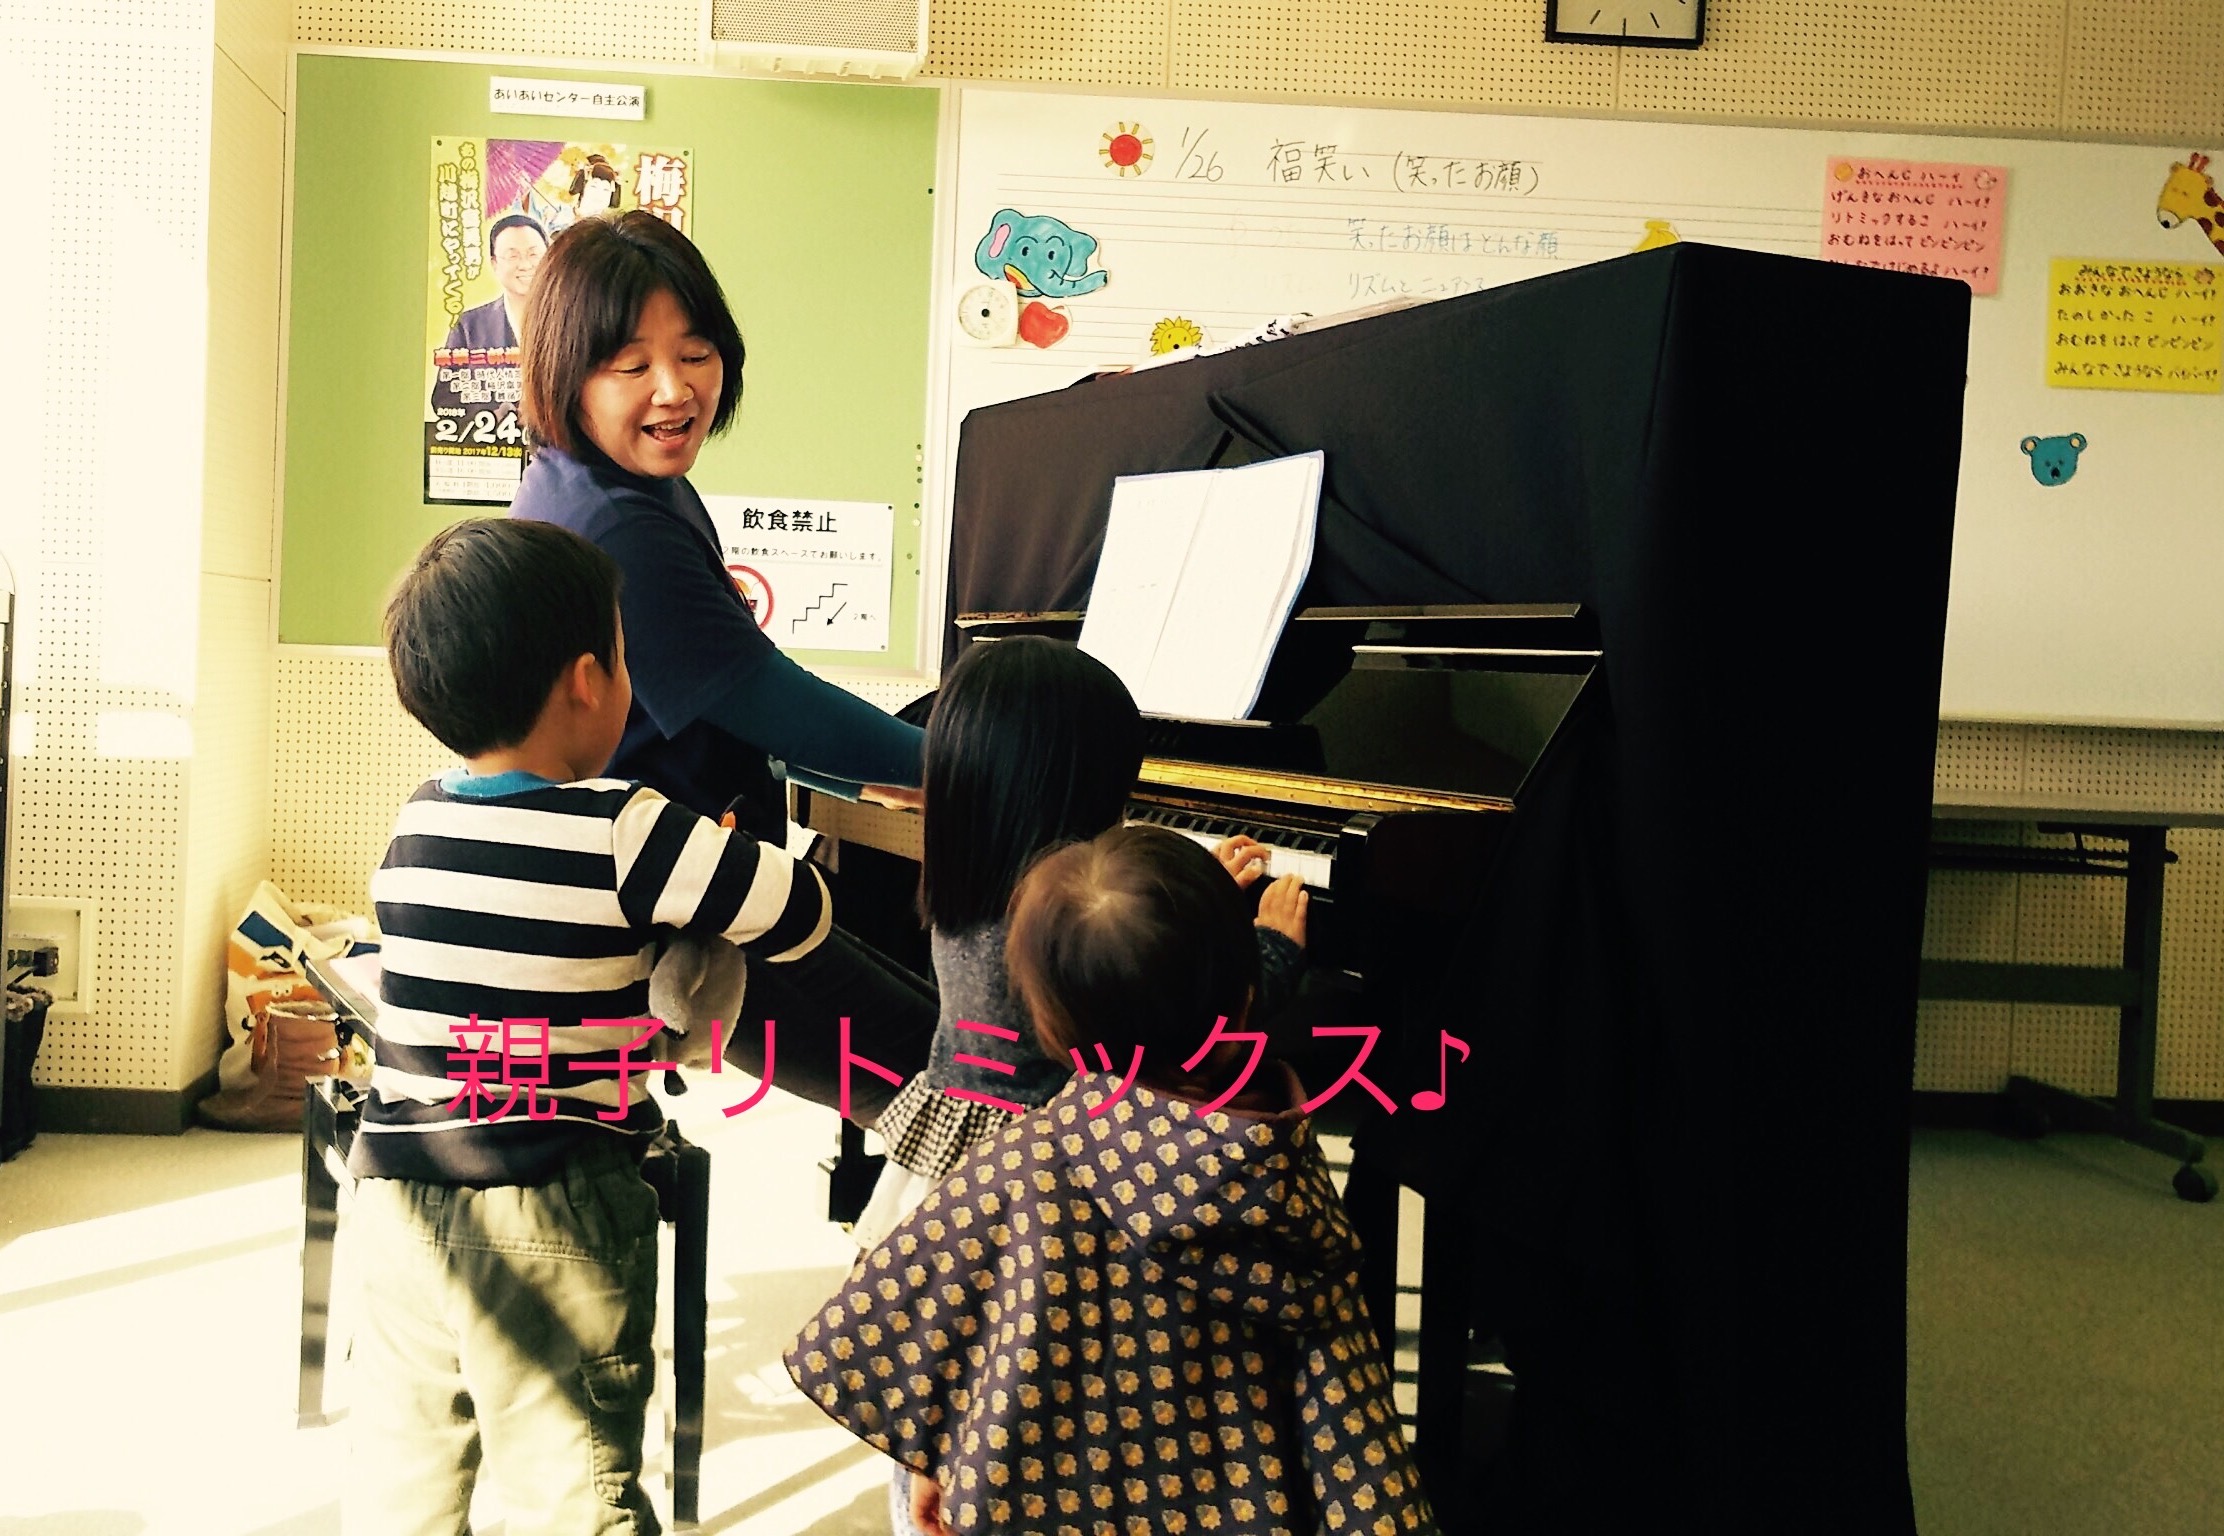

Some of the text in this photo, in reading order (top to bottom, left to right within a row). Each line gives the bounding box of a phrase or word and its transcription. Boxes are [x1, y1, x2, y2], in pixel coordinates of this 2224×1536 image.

[494, 88, 640, 106] あいあいセンター自主公演
[1175, 127, 1223, 182] 1/26
[1267, 139, 1369, 182] 福笑い
[1831, 212, 1929, 226] リトミックするこ
[742, 507, 837, 533] 飲食禁止
